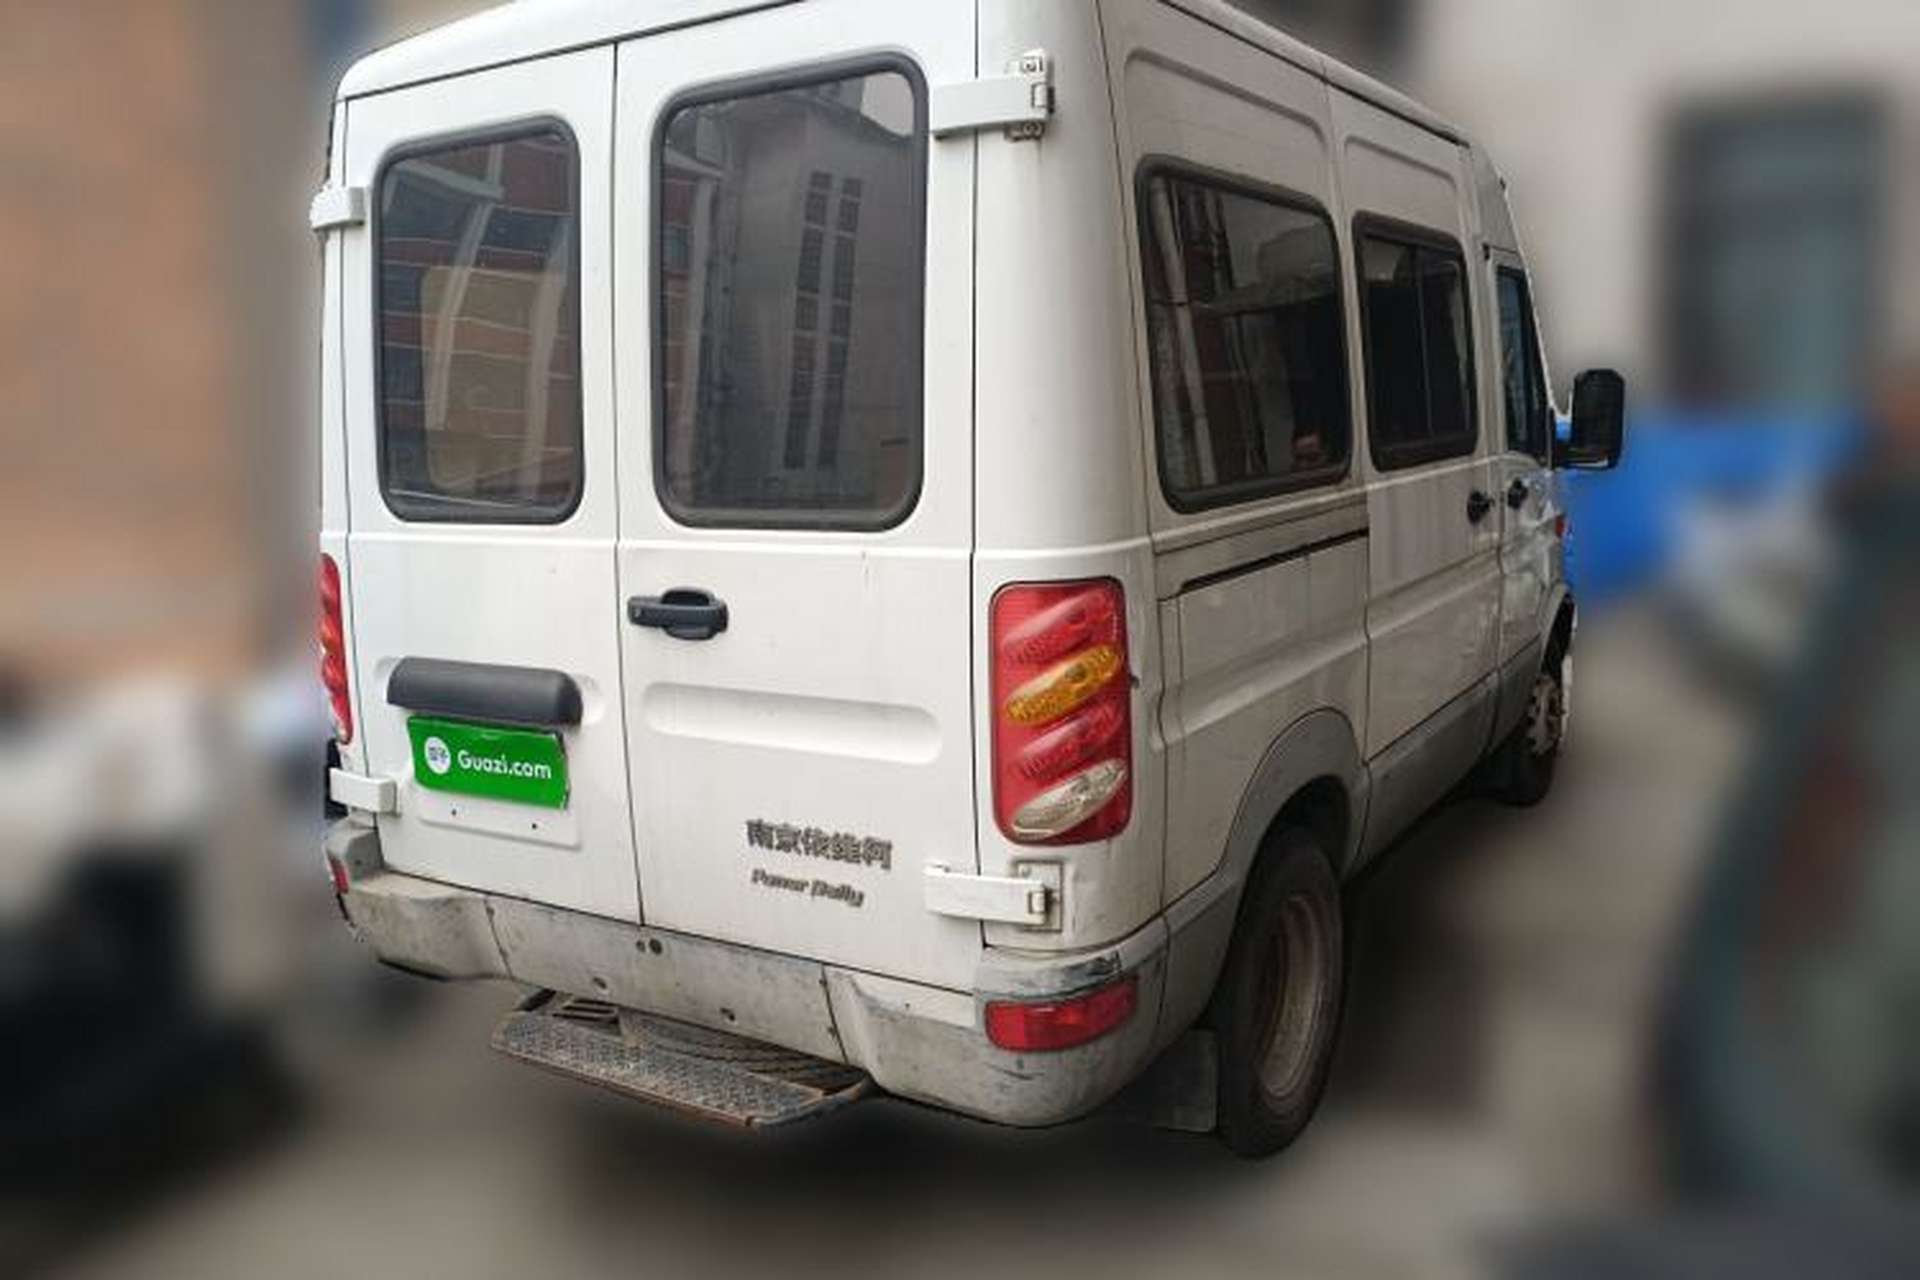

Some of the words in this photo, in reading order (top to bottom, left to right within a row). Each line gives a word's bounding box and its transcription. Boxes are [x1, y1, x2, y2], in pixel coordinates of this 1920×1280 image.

[457, 749, 552, 779] Guazi.com
[746, 818, 892, 870] 南京依维柯
